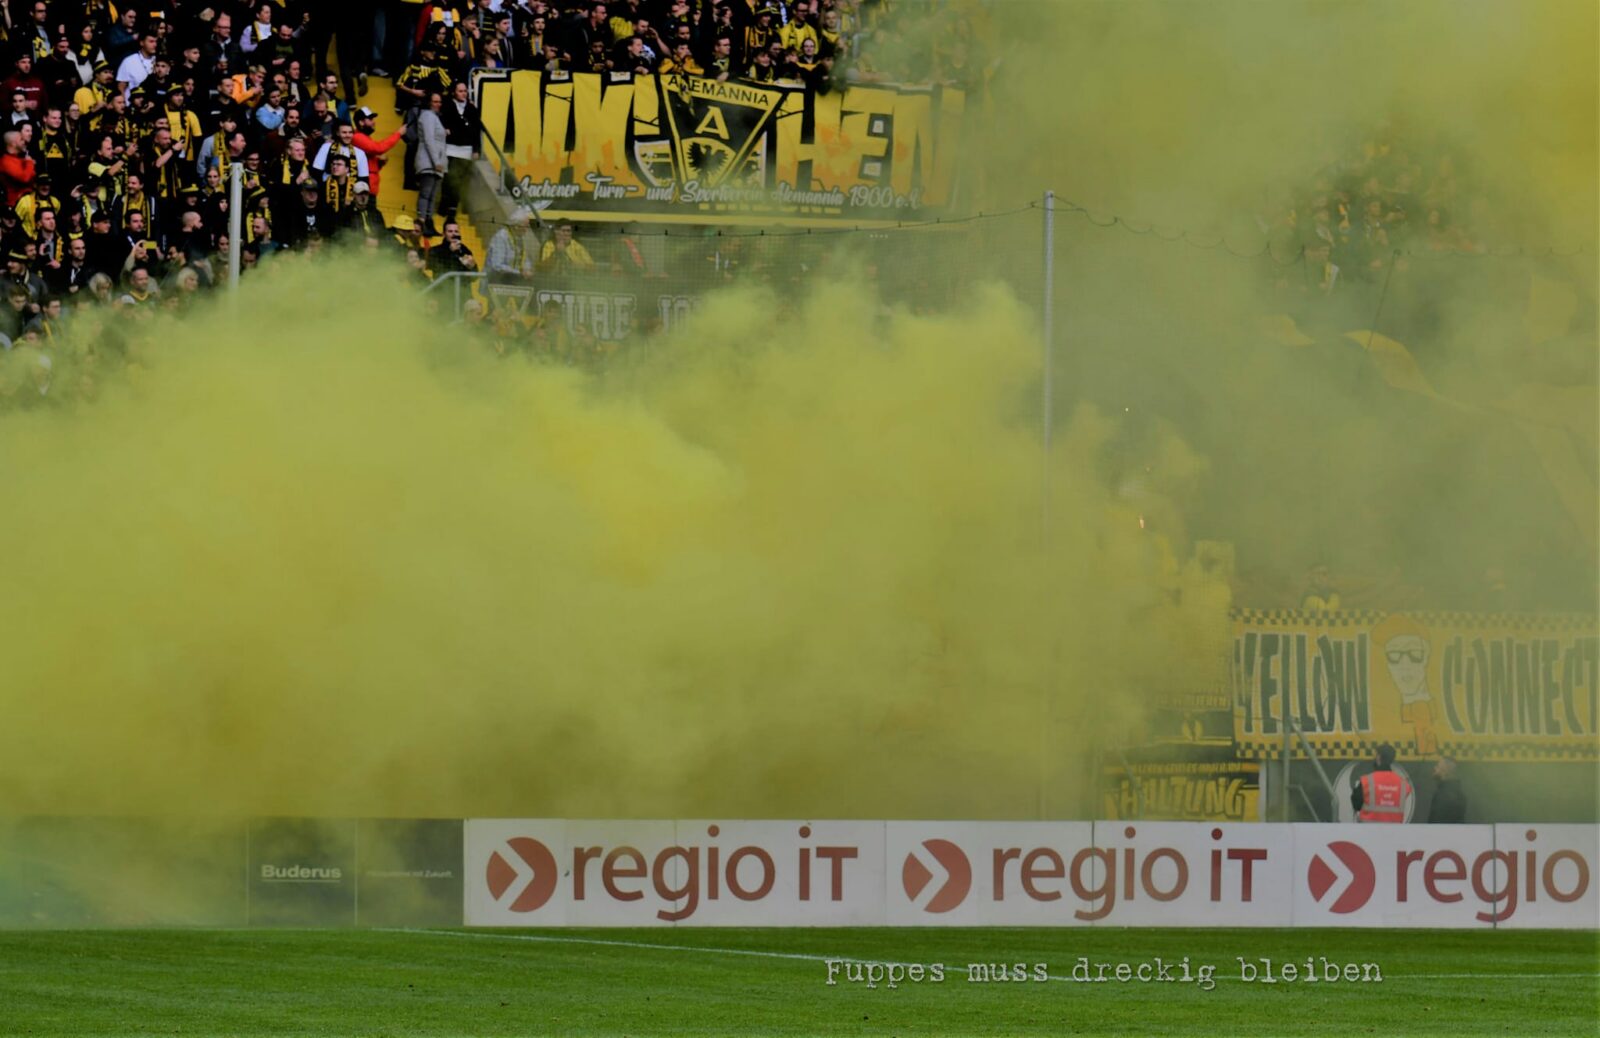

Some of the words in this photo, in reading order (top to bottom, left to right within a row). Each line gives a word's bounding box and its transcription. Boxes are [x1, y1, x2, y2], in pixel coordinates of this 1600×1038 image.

[667, 75, 769, 106] AEMANNIA
[694, 105, 730, 140] A
[513, 175, 580, 198] Aachener
[586, 173, 638, 200] Turn-
[647, 181, 673, 201] und
[680, 180, 764, 204] Sportverein
[771, 182, 845, 206] Alemannia
[849, 185, 893, 208] 1900
[1233, 631, 1372, 735] YELLOW
[1120, 775, 1246, 818] HALTUNG
[261, 864, 342, 879] Buderus
[572, 824, 777, 922] regio
[993, 827, 1189, 922] regio
[1396, 829, 1590, 923] regio
